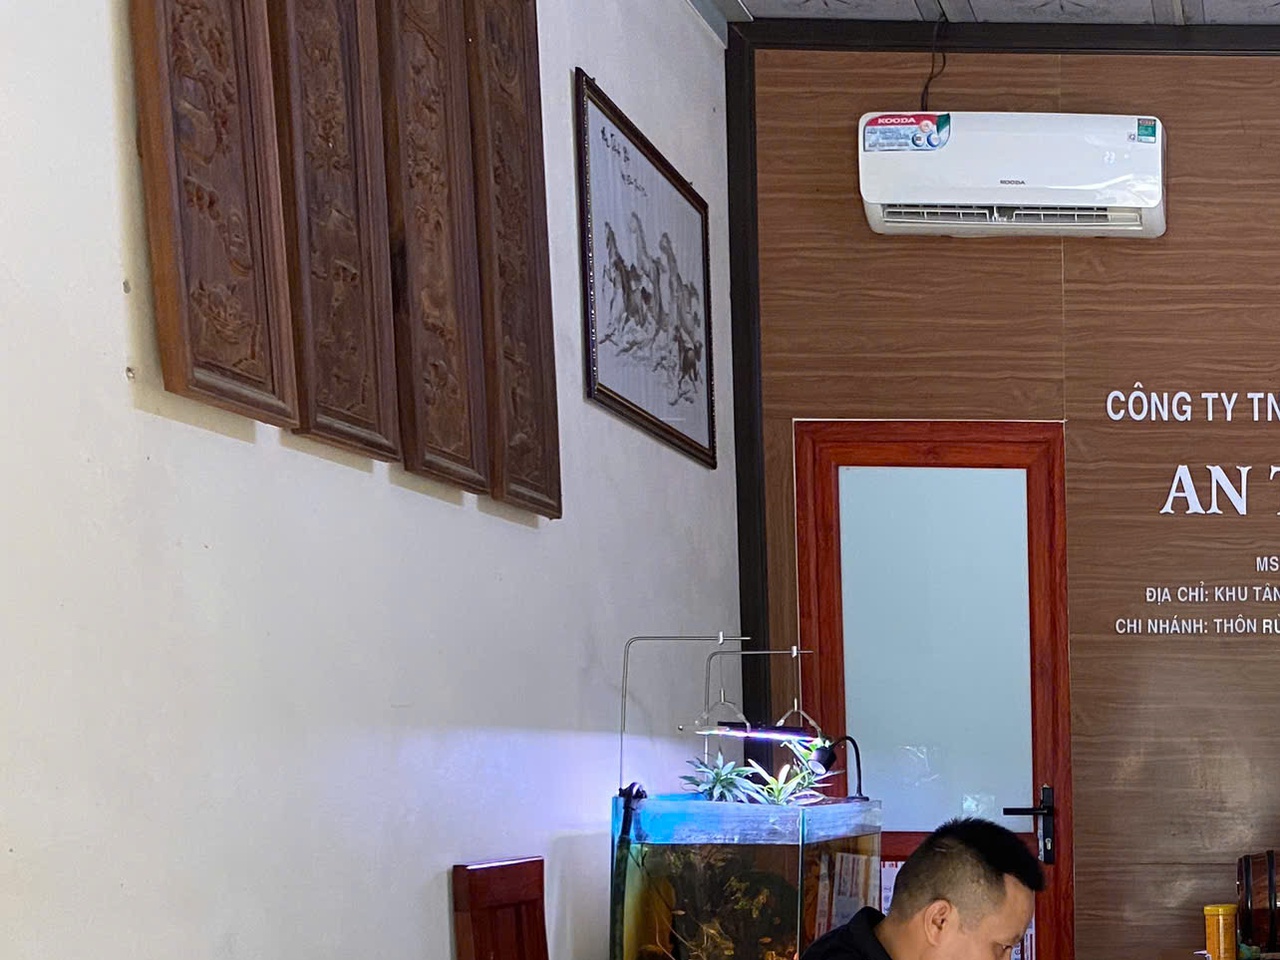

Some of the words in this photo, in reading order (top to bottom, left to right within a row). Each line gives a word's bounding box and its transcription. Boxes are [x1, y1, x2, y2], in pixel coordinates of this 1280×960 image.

[877, 116, 916, 124] KOODA
[1106, 382, 1191, 422] CÔNG
[1202, 392, 1238, 422] TY
[1159, 464, 1252, 516] AN
[1146, 587, 1171, 605] ĐỊA
[1177, 581, 1208, 602] CHỈ:
[1214, 586, 1248, 602] KHU
[1115, 618, 1142, 634] CHI
[1147, 614, 1208, 634] NHÁNH:
[1213, 614, 1257, 634] THÔN
